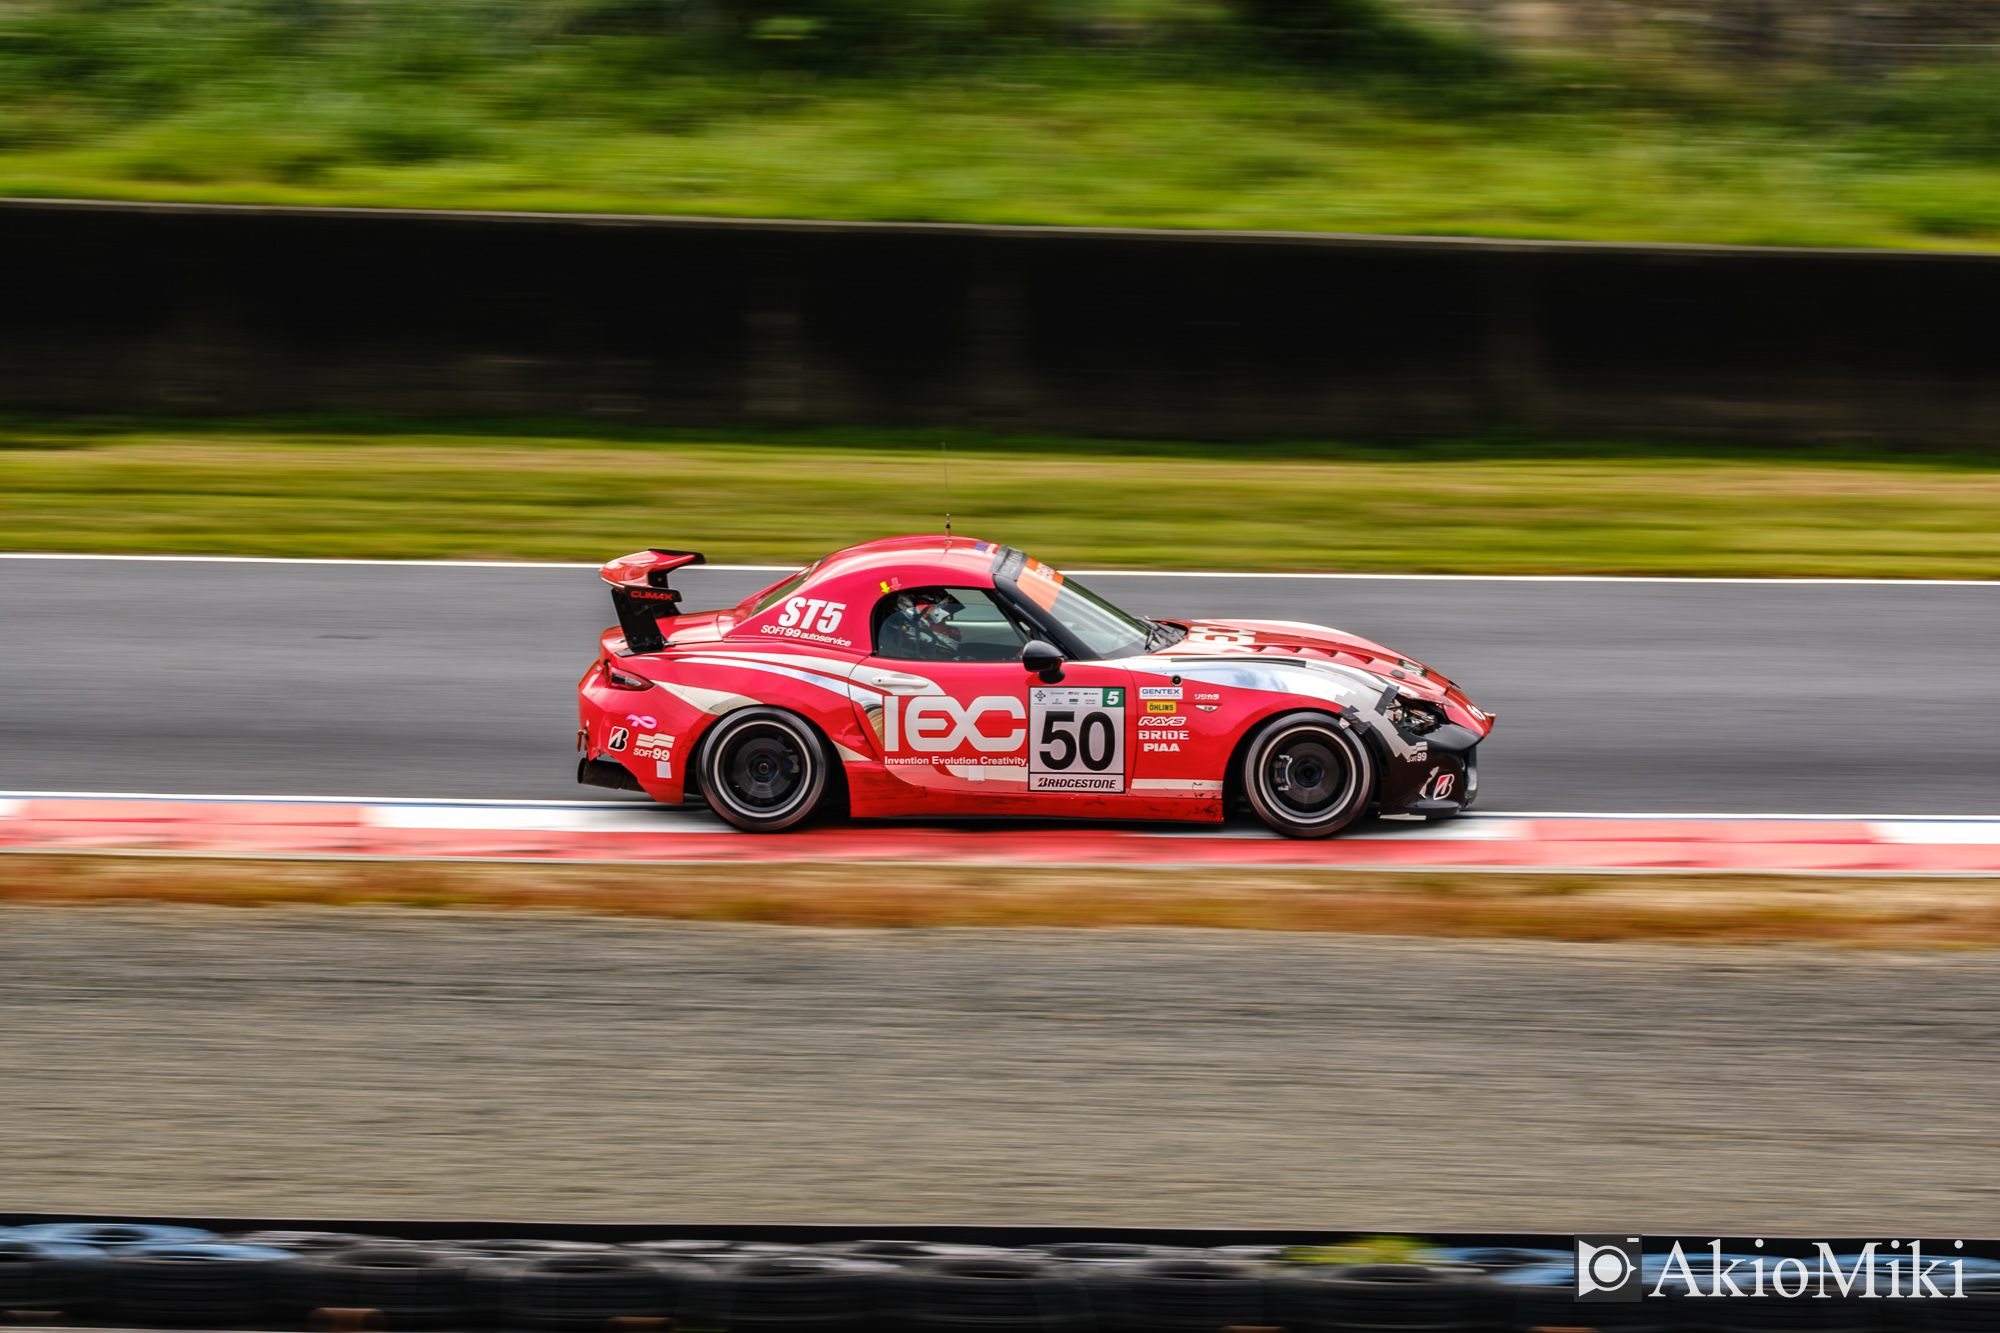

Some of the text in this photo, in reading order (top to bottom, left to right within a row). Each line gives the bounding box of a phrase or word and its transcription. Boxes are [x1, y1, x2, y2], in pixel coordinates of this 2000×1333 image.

[631, 590, 673, 601] CLIMAX
[778, 596, 847, 634] ST5
[1106, 691, 1119, 705] 5
[1138, 716, 1187, 726] RAYS
[1138, 730, 1189, 740] BRIDE
[1039, 711, 1116, 771] 50
[1143, 743, 1180, 752] PIAA
[884, 755, 1027, 766] Invention Evolution Creativity
[1037, 777, 1117, 789] BRIDGESTONE
